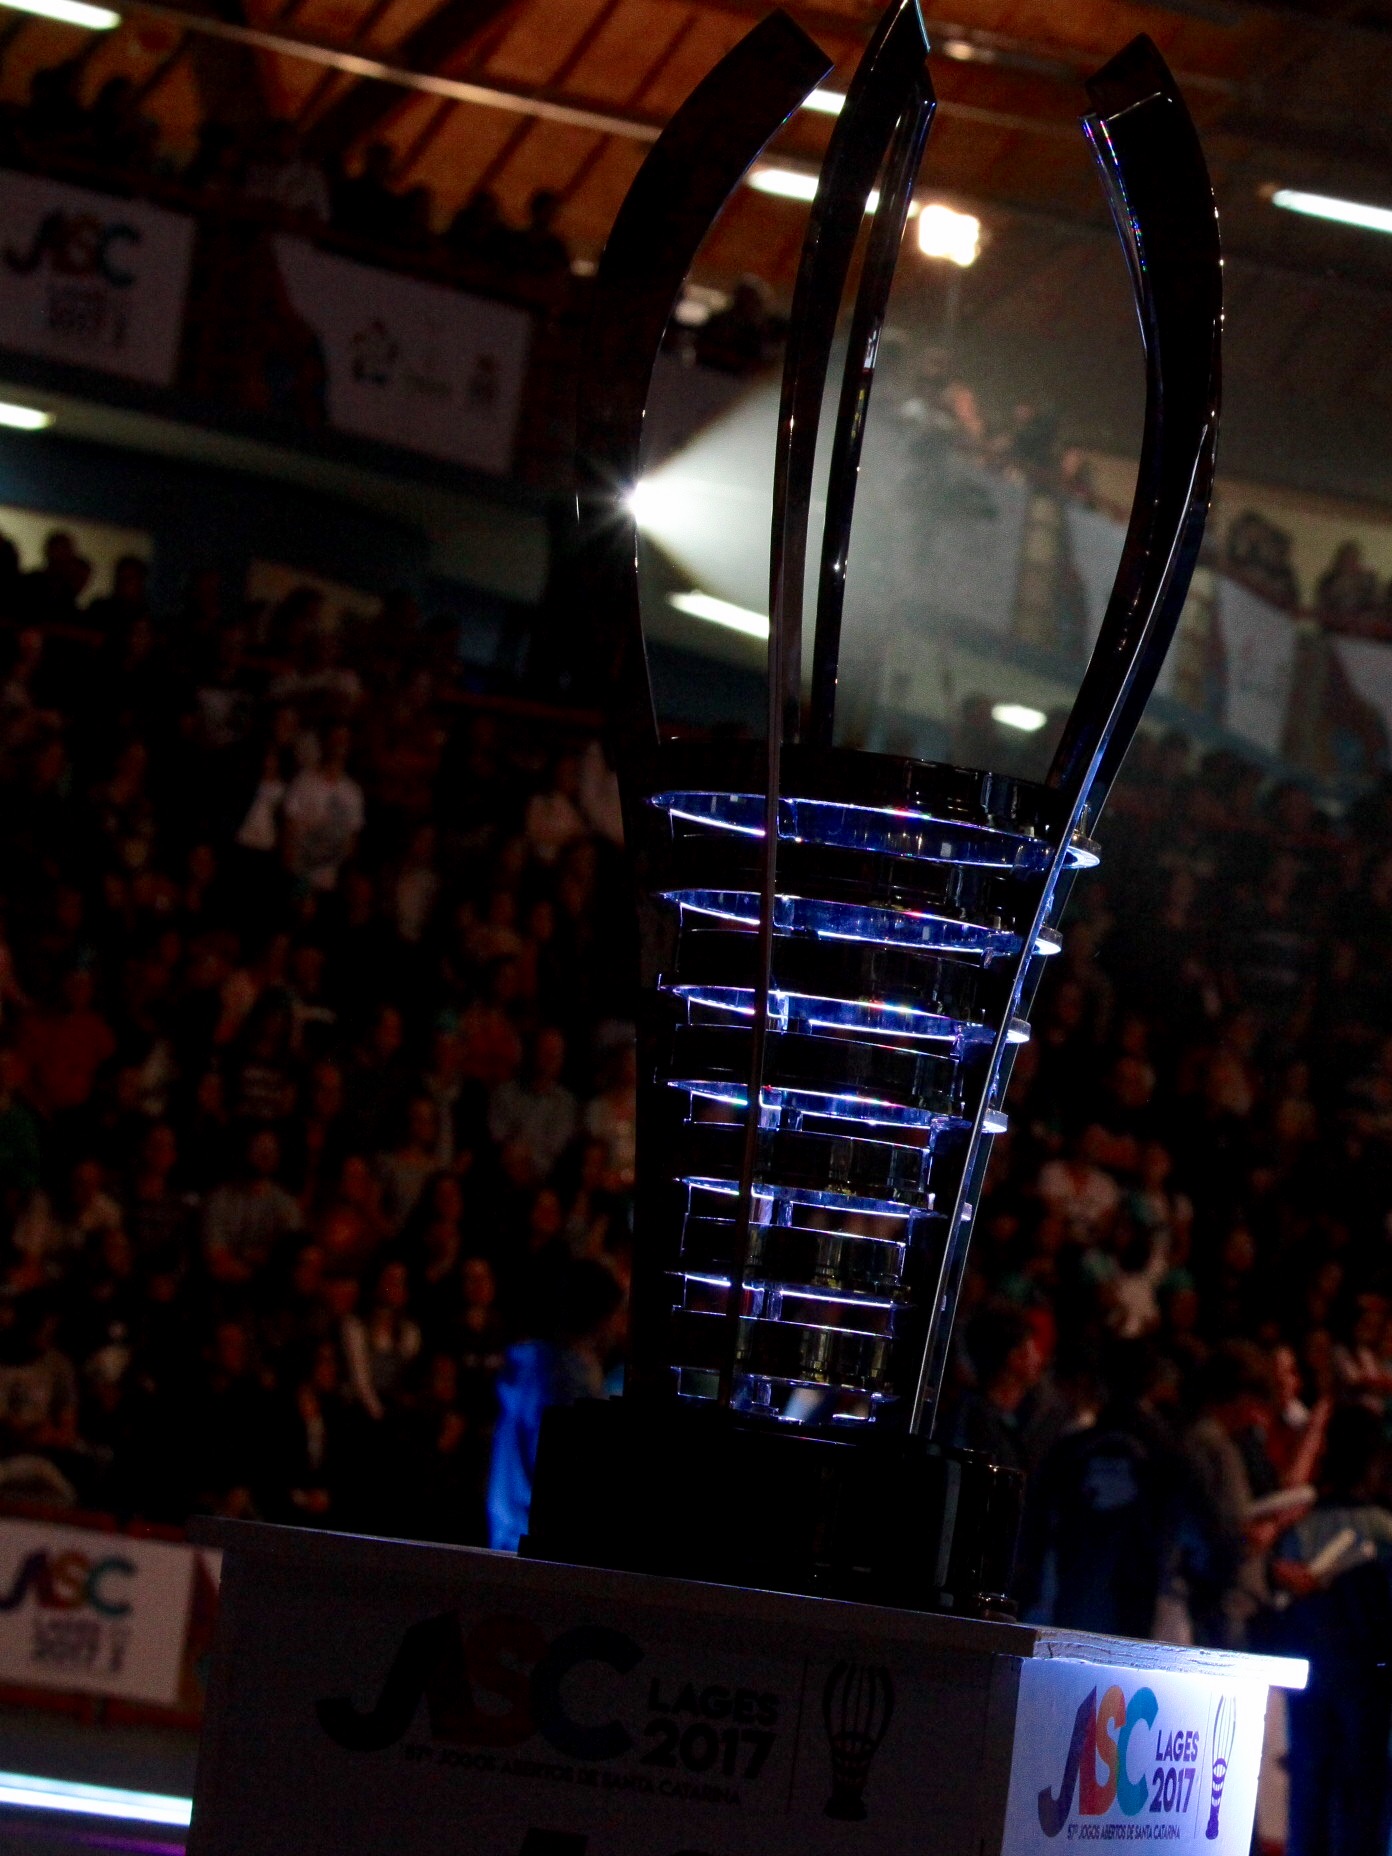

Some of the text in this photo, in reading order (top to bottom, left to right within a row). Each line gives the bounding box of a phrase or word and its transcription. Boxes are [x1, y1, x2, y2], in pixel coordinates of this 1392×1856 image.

[647, 1677, 781, 1727] LAGES
[640, 1717, 777, 1780] 2017
[1155, 1730, 1200, 1762] LAGES
[438, 1748, 497, 1772] JOGOS
[500, 1757, 575, 1780] ABERTOS
[576, 1767, 599, 1786] DE
[601, 1770, 655, 1795] SANTA
[658, 1777, 742, 1806] CATARINA
[1149, 1767, 1196, 1813] 2017
[1078, 1823, 1100, 1840] JOGOS
[1135, 1823, 1153, 1840] SANTA
[1153, 1823, 1181, 1840] CATARINA
